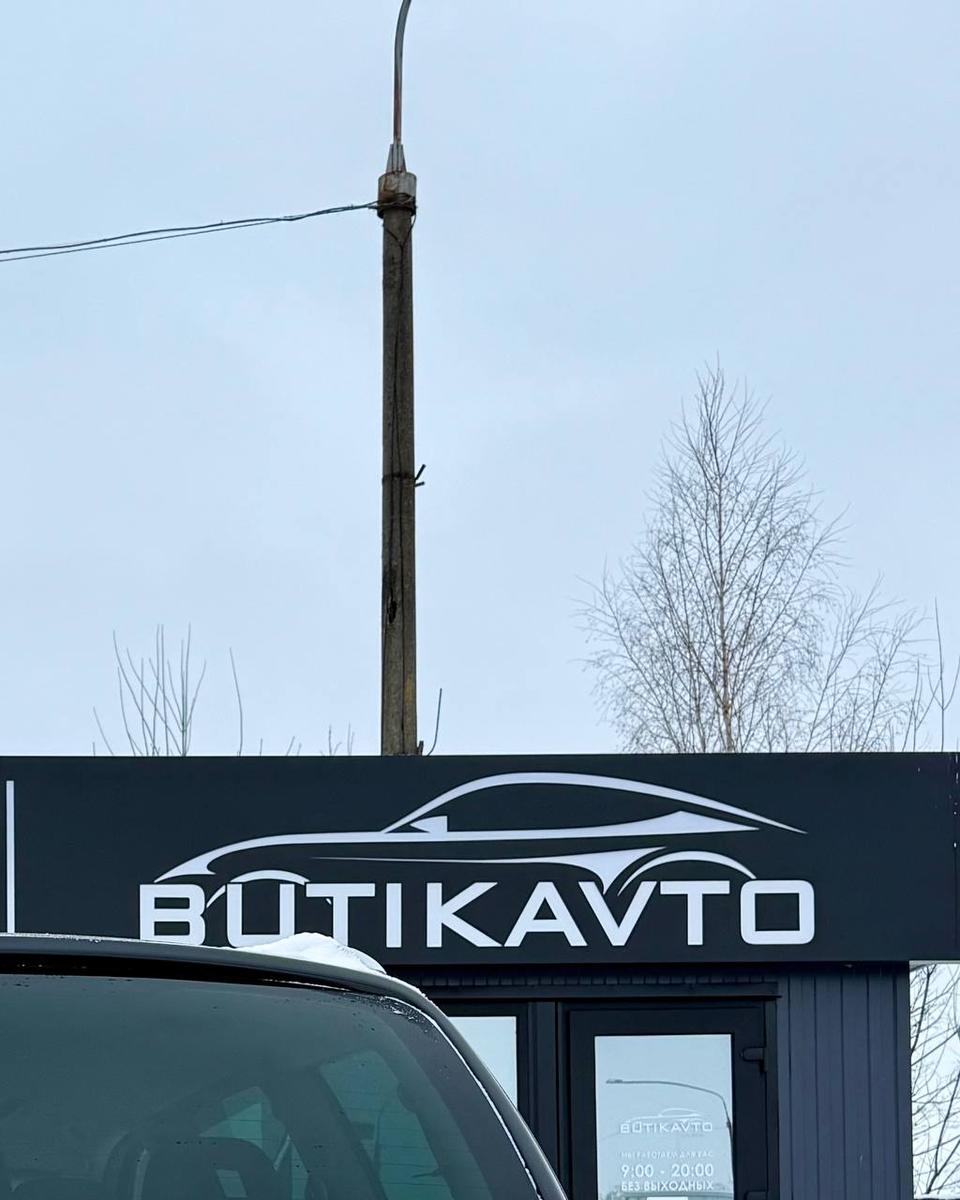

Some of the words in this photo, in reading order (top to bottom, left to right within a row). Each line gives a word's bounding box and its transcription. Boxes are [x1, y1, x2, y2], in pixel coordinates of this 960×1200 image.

[139, 880, 815, 947] BUTIKAVTO
[620, 1121, 713, 1133] BUTIKAVTO
[621, 1164, 654, 1177] 9:00
[671, 1163, 714, 1177] 20:00
[621, 1181, 640, 1191] БЕЗ
[643, 1181, 714, 1191] ВЫХОДНЫХ
